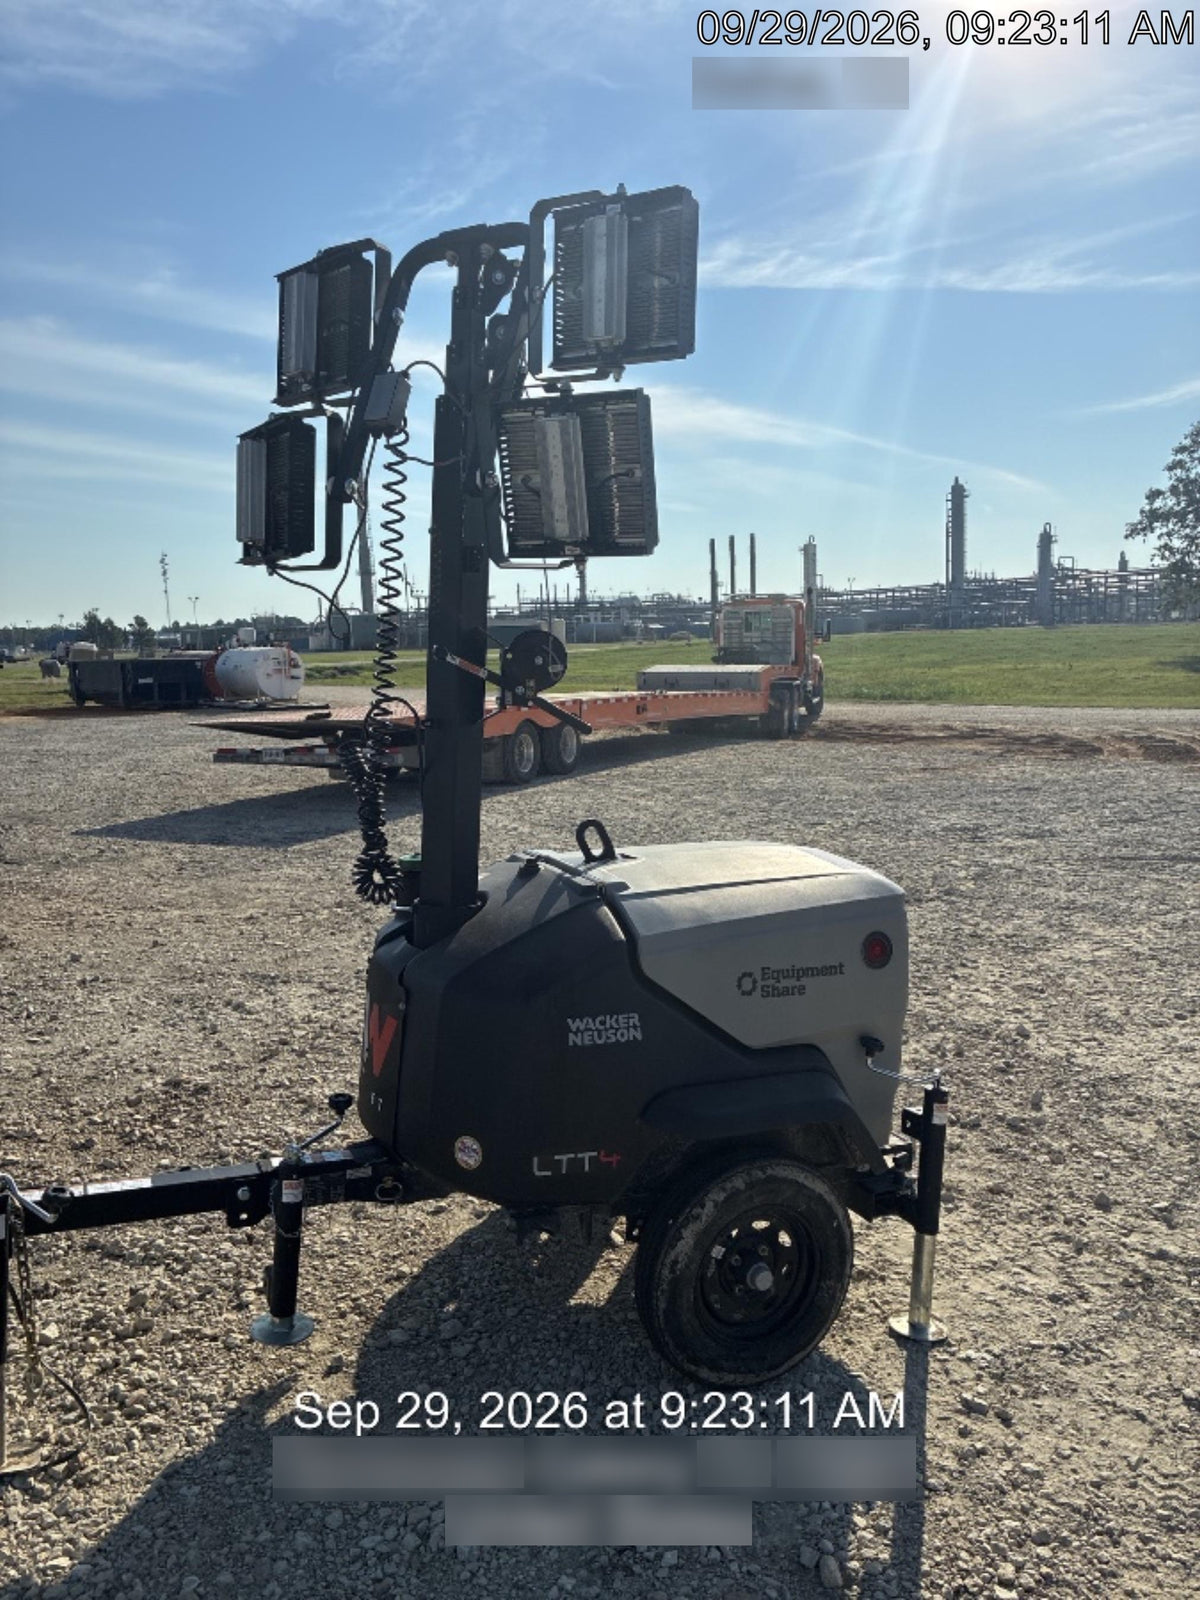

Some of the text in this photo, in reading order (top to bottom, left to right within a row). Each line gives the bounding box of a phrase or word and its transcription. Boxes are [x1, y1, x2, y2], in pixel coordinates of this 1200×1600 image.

[760, 962, 845, 984] Equipment
[760, 984, 806, 998] Share
[567, 1013, 641, 1032] WACKER
[568, 1027, 642, 1046] NEUSON
[533, 1150, 620, 1176] LTT4
